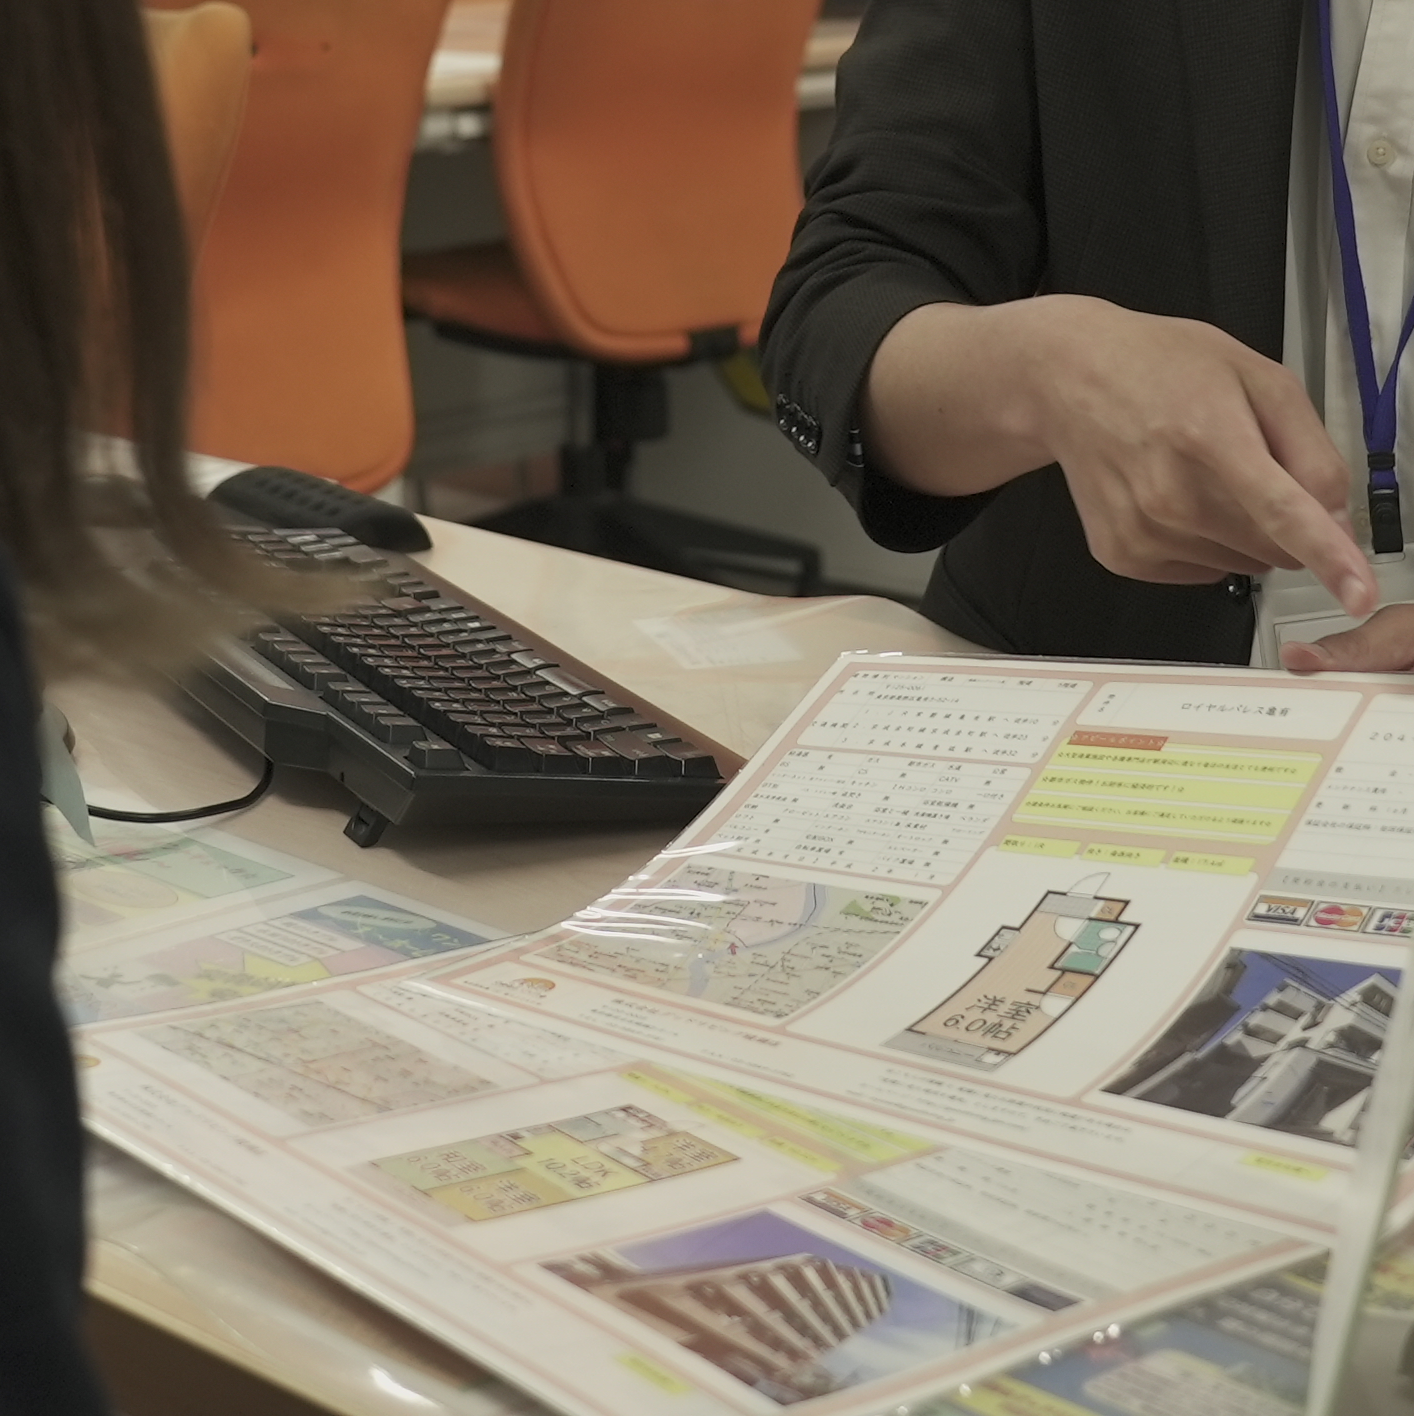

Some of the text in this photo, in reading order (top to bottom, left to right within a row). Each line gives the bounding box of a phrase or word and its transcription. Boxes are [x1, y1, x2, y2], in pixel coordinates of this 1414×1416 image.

[1181, 701, 1291, 718] ロイヤルパレス亀有
[1265, 903, 1298, 916] VISA
[965, 994, 1039, 1022] 洋室
[943, 1014, 1020, 1041] 6.0帖
[570, 1154, 613, 1179] LDK
